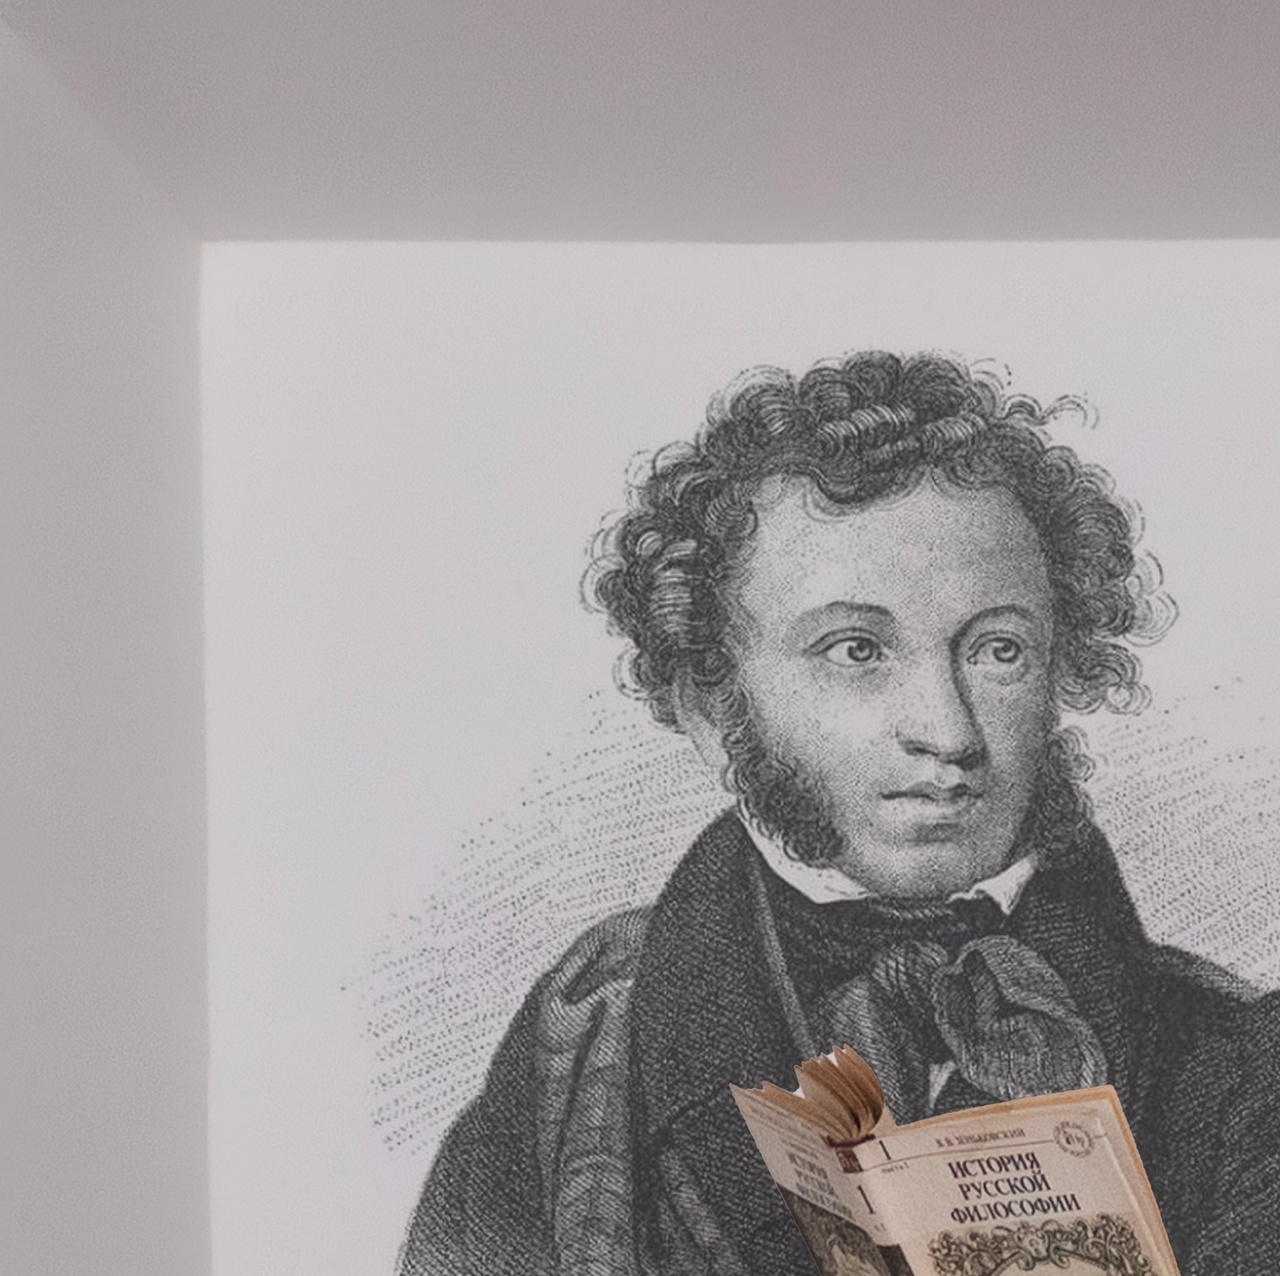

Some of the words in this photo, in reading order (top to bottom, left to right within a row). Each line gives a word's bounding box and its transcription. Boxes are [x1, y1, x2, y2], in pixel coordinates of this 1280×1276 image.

[947, 1151, 1042, 1179] ИСТОРИЯ
[958, 1169, 1051, 1201] РУССКОЙ
[950, 1193, 1082, 1224] ФИЛОСОФИИ
